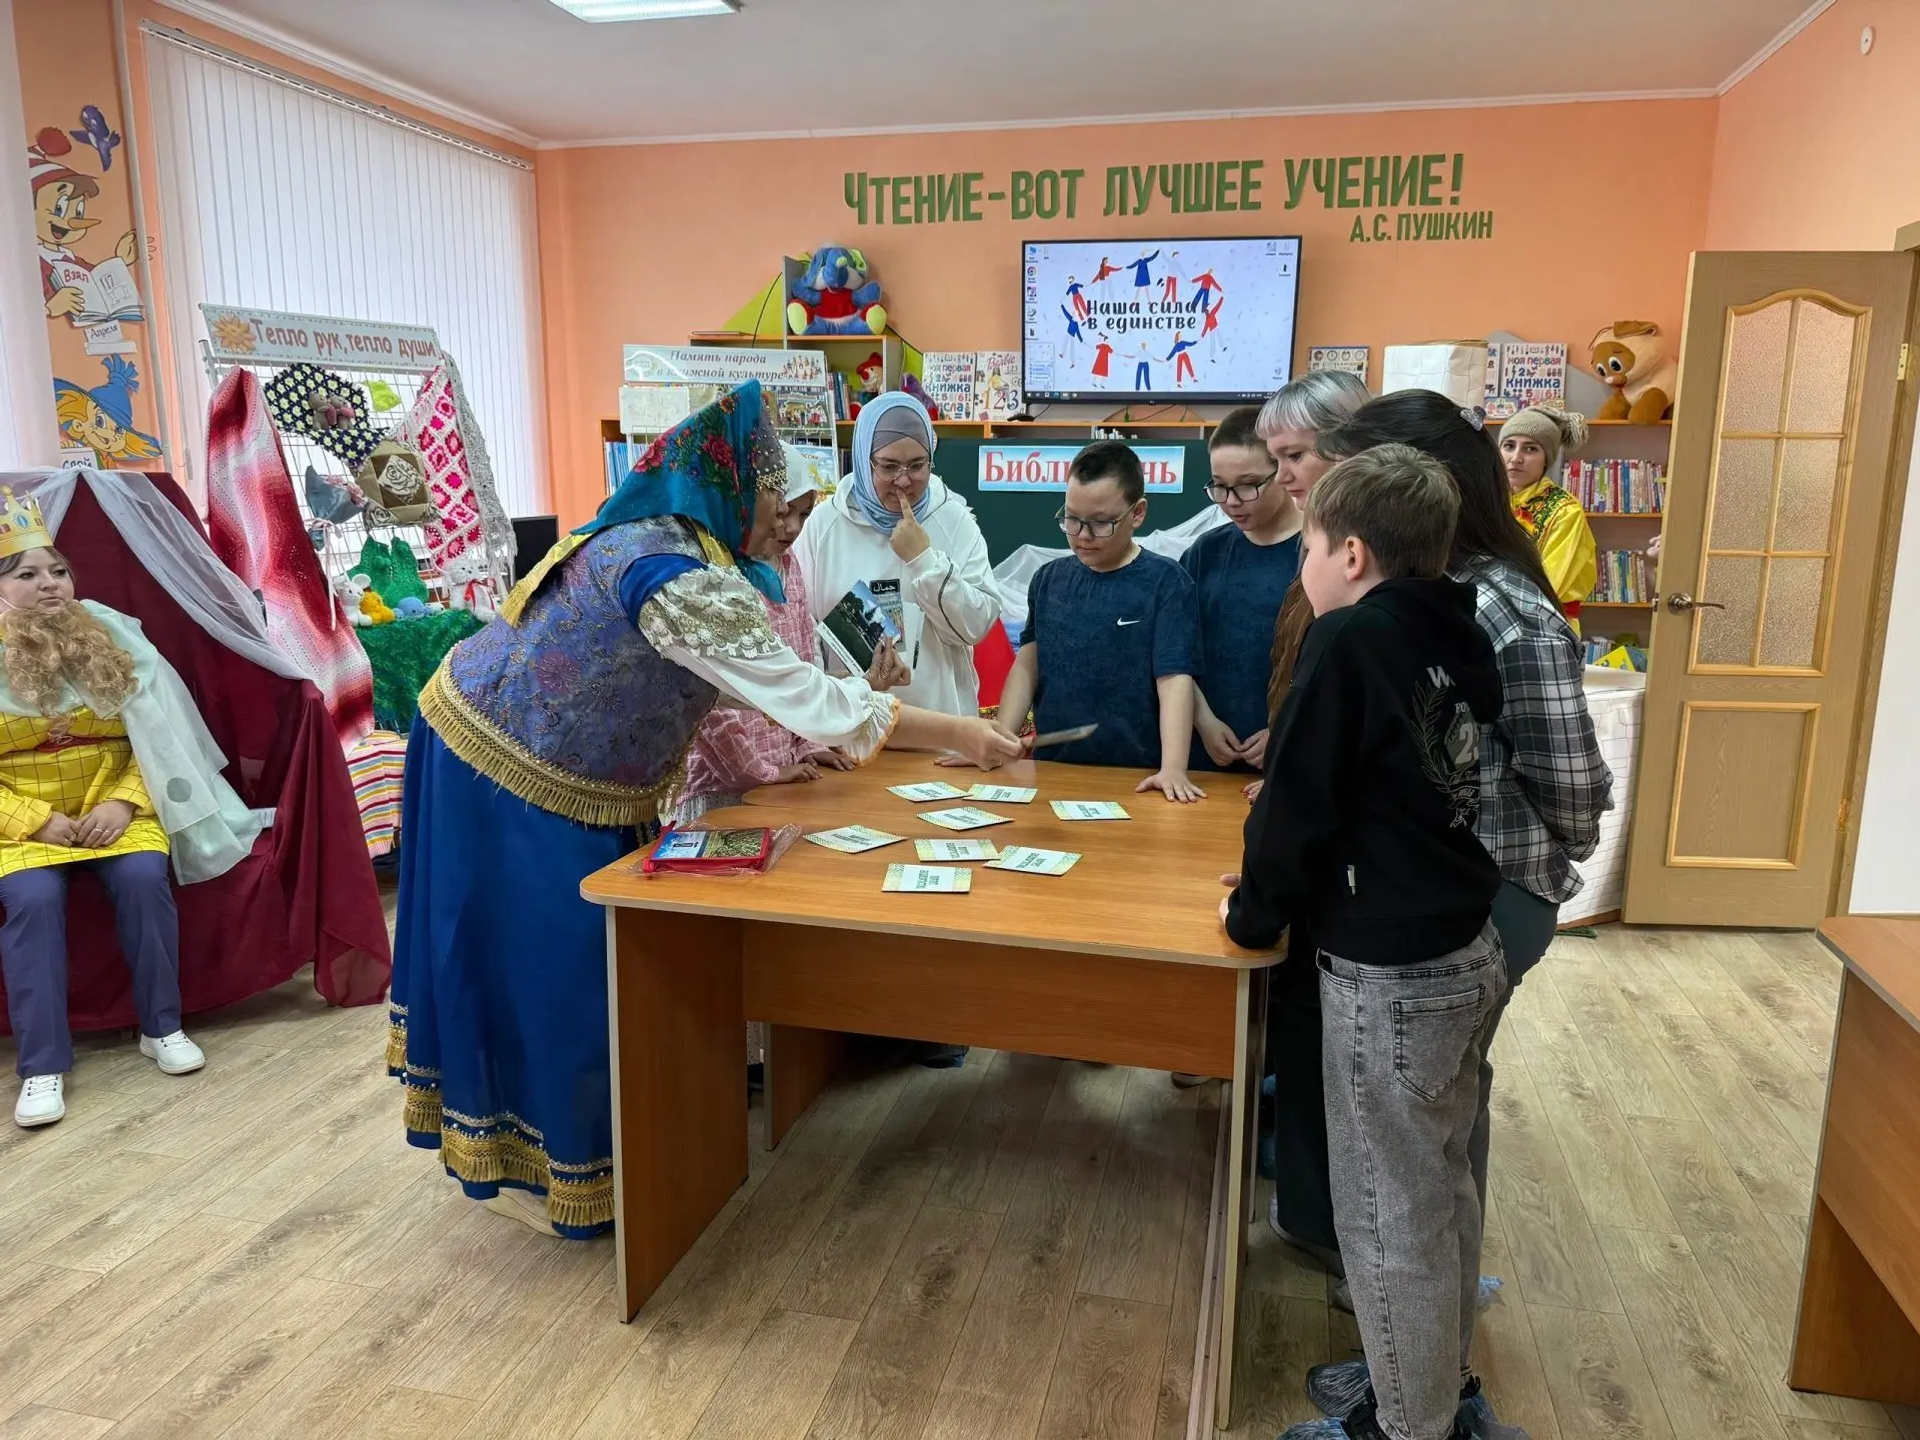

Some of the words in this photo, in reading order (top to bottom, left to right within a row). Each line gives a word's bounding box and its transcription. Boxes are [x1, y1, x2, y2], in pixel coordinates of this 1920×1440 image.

[1103, 159, 1264, 217] ЛУЧШЕЕ
[1283, 153, 1464, 210] УЧЕНИЕ!
[63, 269, 90, 283] Взял
[1086, 300, 1140, 315] Наша
[1148, 301, 1196, 314] сила
[90, 324, 119, 338] Апреля
[1087, 317, 1098, 330] в
[1106, 316, 1196, 334] единстве
[250, 318, 308, 348] Тепло
[398, 337, 437, 362] души
[669, 350, 721, 363] Память
[724, 354, 767, 365] народа
[1527, 357, 1561, 367] первая
[667, 366, 724, 378] кижной
[728, 368, 783, 382] культуре
[1506, 378, 1561, 388] книжка
[985, 451, 1177, 484] Библчь
